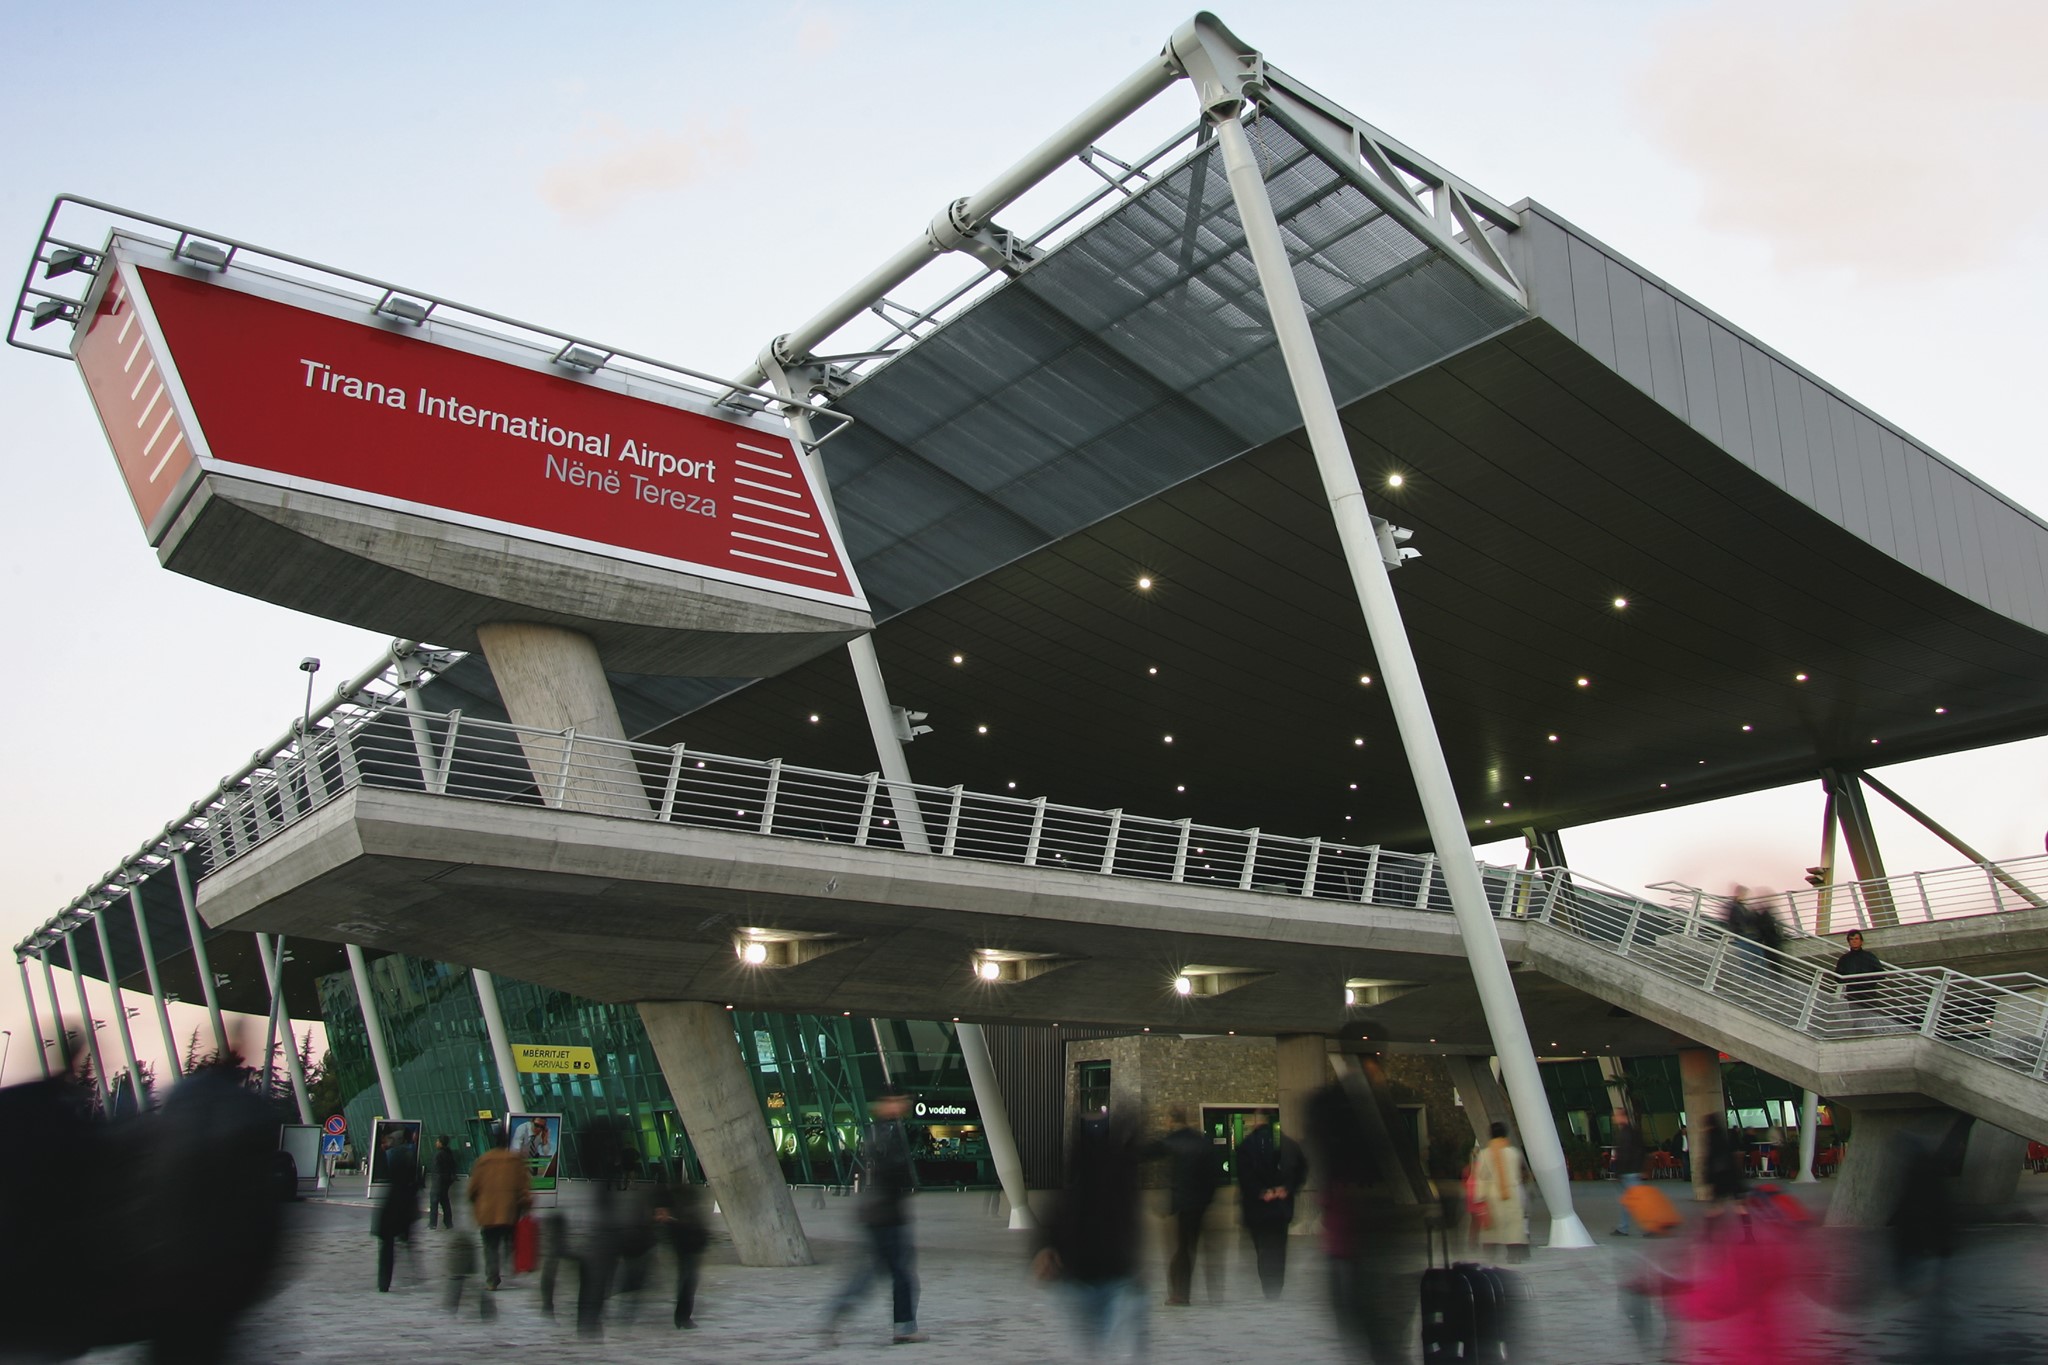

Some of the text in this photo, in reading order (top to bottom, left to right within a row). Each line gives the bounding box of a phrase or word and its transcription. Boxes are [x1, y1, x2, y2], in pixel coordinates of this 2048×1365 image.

[300, 359, 717, 484] Tirana International Airport
[545, 453, 717, 519] Nënë Tereza
[533, 1060, 569, 1069] ARRIVALS
[929, 1105, 966, 1114] vodafone
